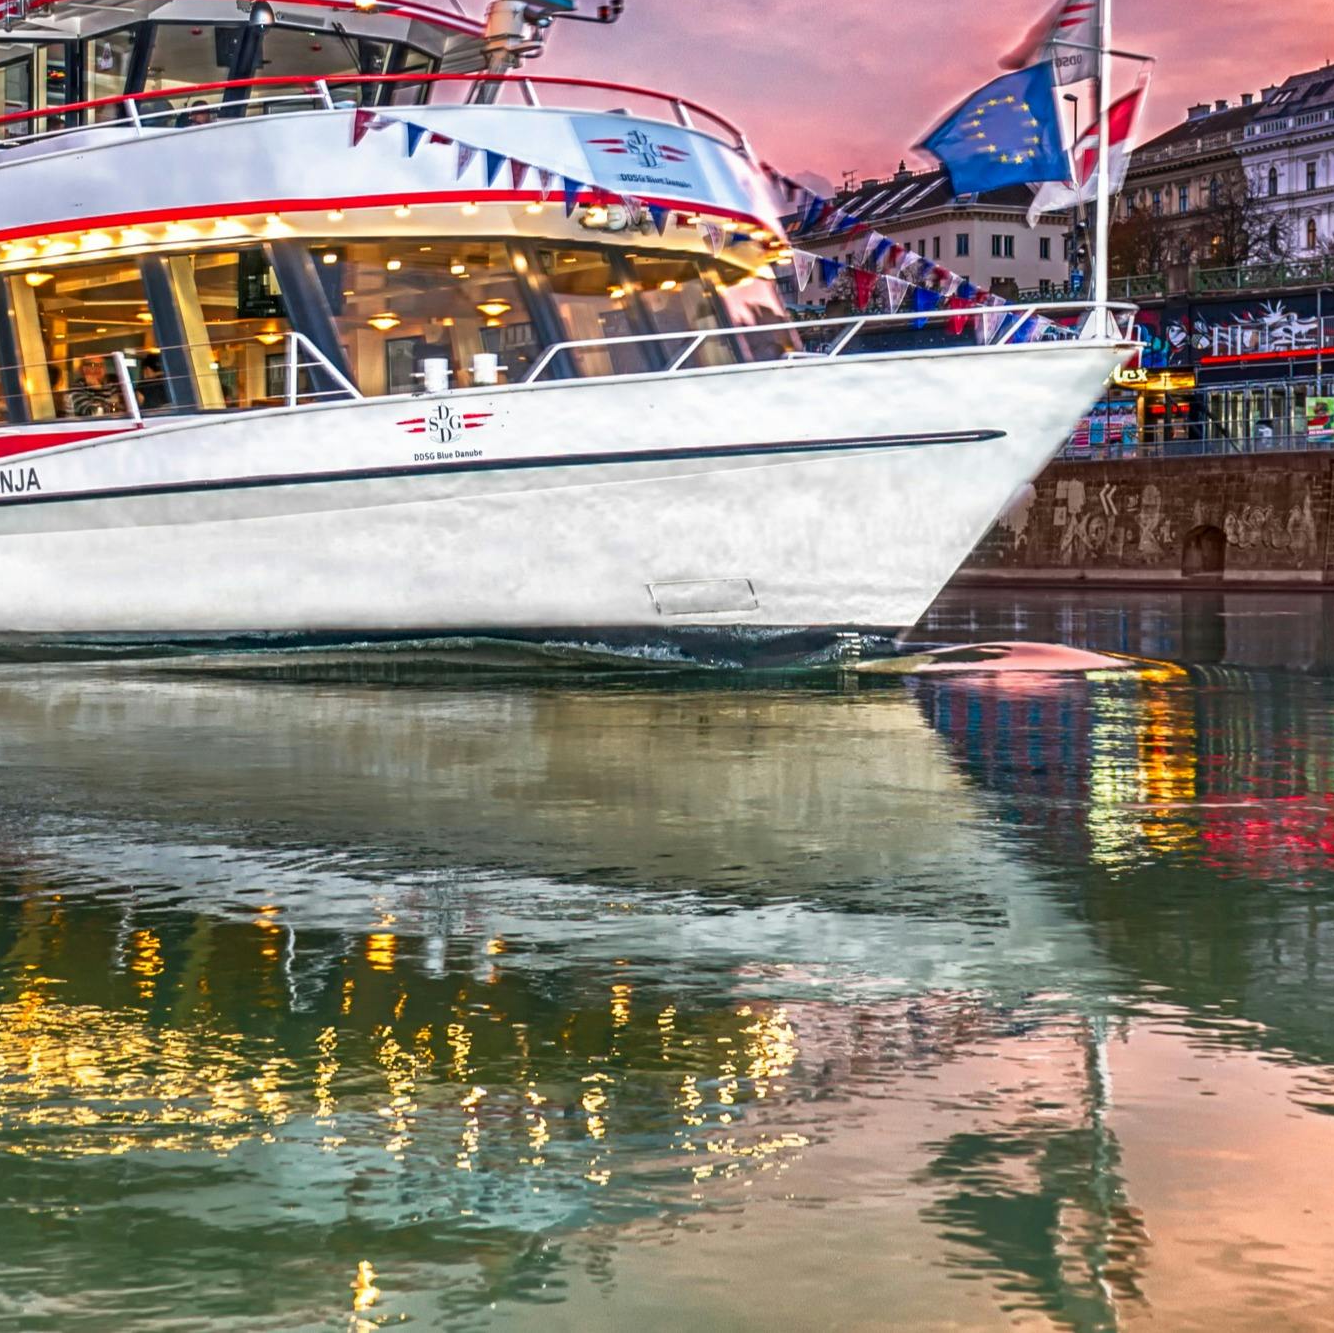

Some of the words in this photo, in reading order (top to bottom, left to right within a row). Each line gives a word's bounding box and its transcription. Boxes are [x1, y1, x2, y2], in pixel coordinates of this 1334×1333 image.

[1103, 363, 1148, 385] lex
[414, 452, 435, 461] DDSG
[437, 451, 453, 460] Blue
[455, 449, 483, 458] Danube
